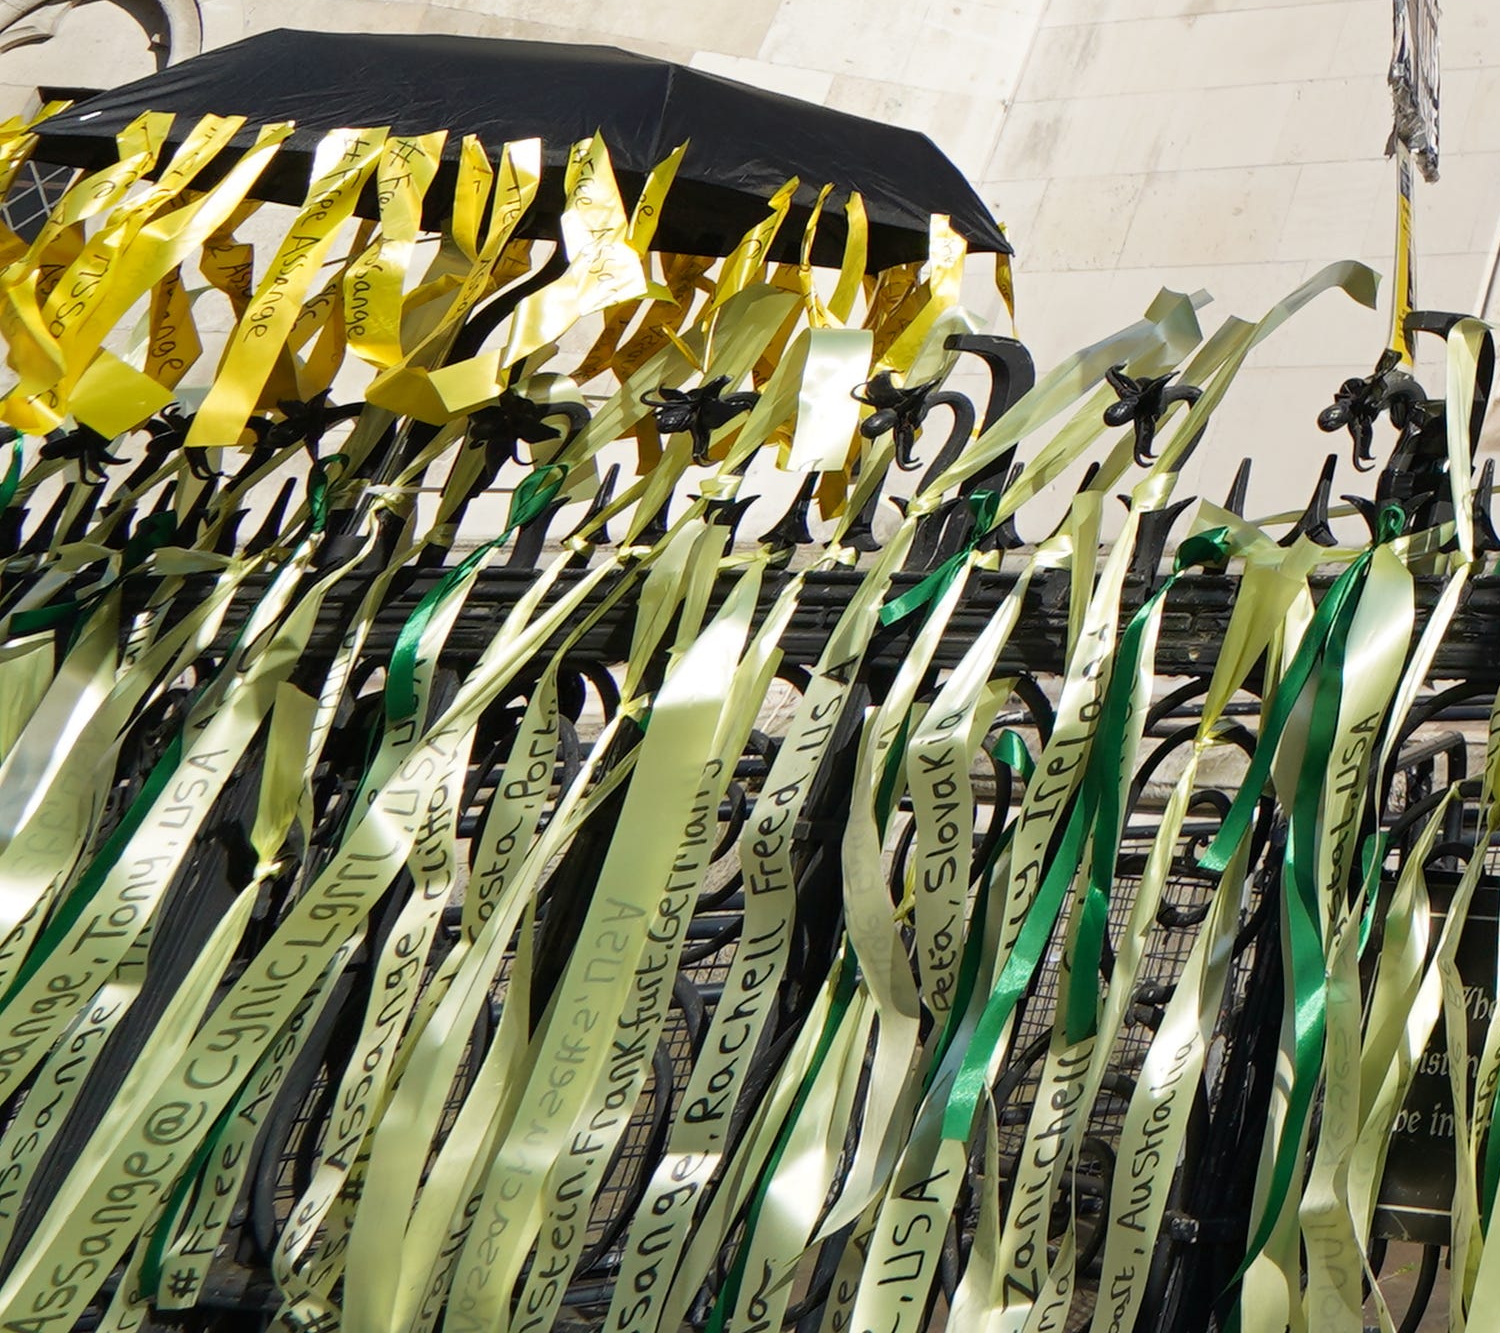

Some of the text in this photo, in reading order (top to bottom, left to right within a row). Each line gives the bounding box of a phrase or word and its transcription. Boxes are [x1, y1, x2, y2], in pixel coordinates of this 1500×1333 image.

[243, 235, 321, 342] Assange
[159, 748, 230, 829] USA
[917, 701, 972, 893] Slovakia
[1335, 712, 1380, 795] USA
[683, 918, 786, 1124] Rachell
[796, 653, 861, 753] USA
[1002, 1043, 1095, 1313] Zanichell
[1115, 1030, 1200, 1232] Australia
[877, 1169, 950, 1286] USA
